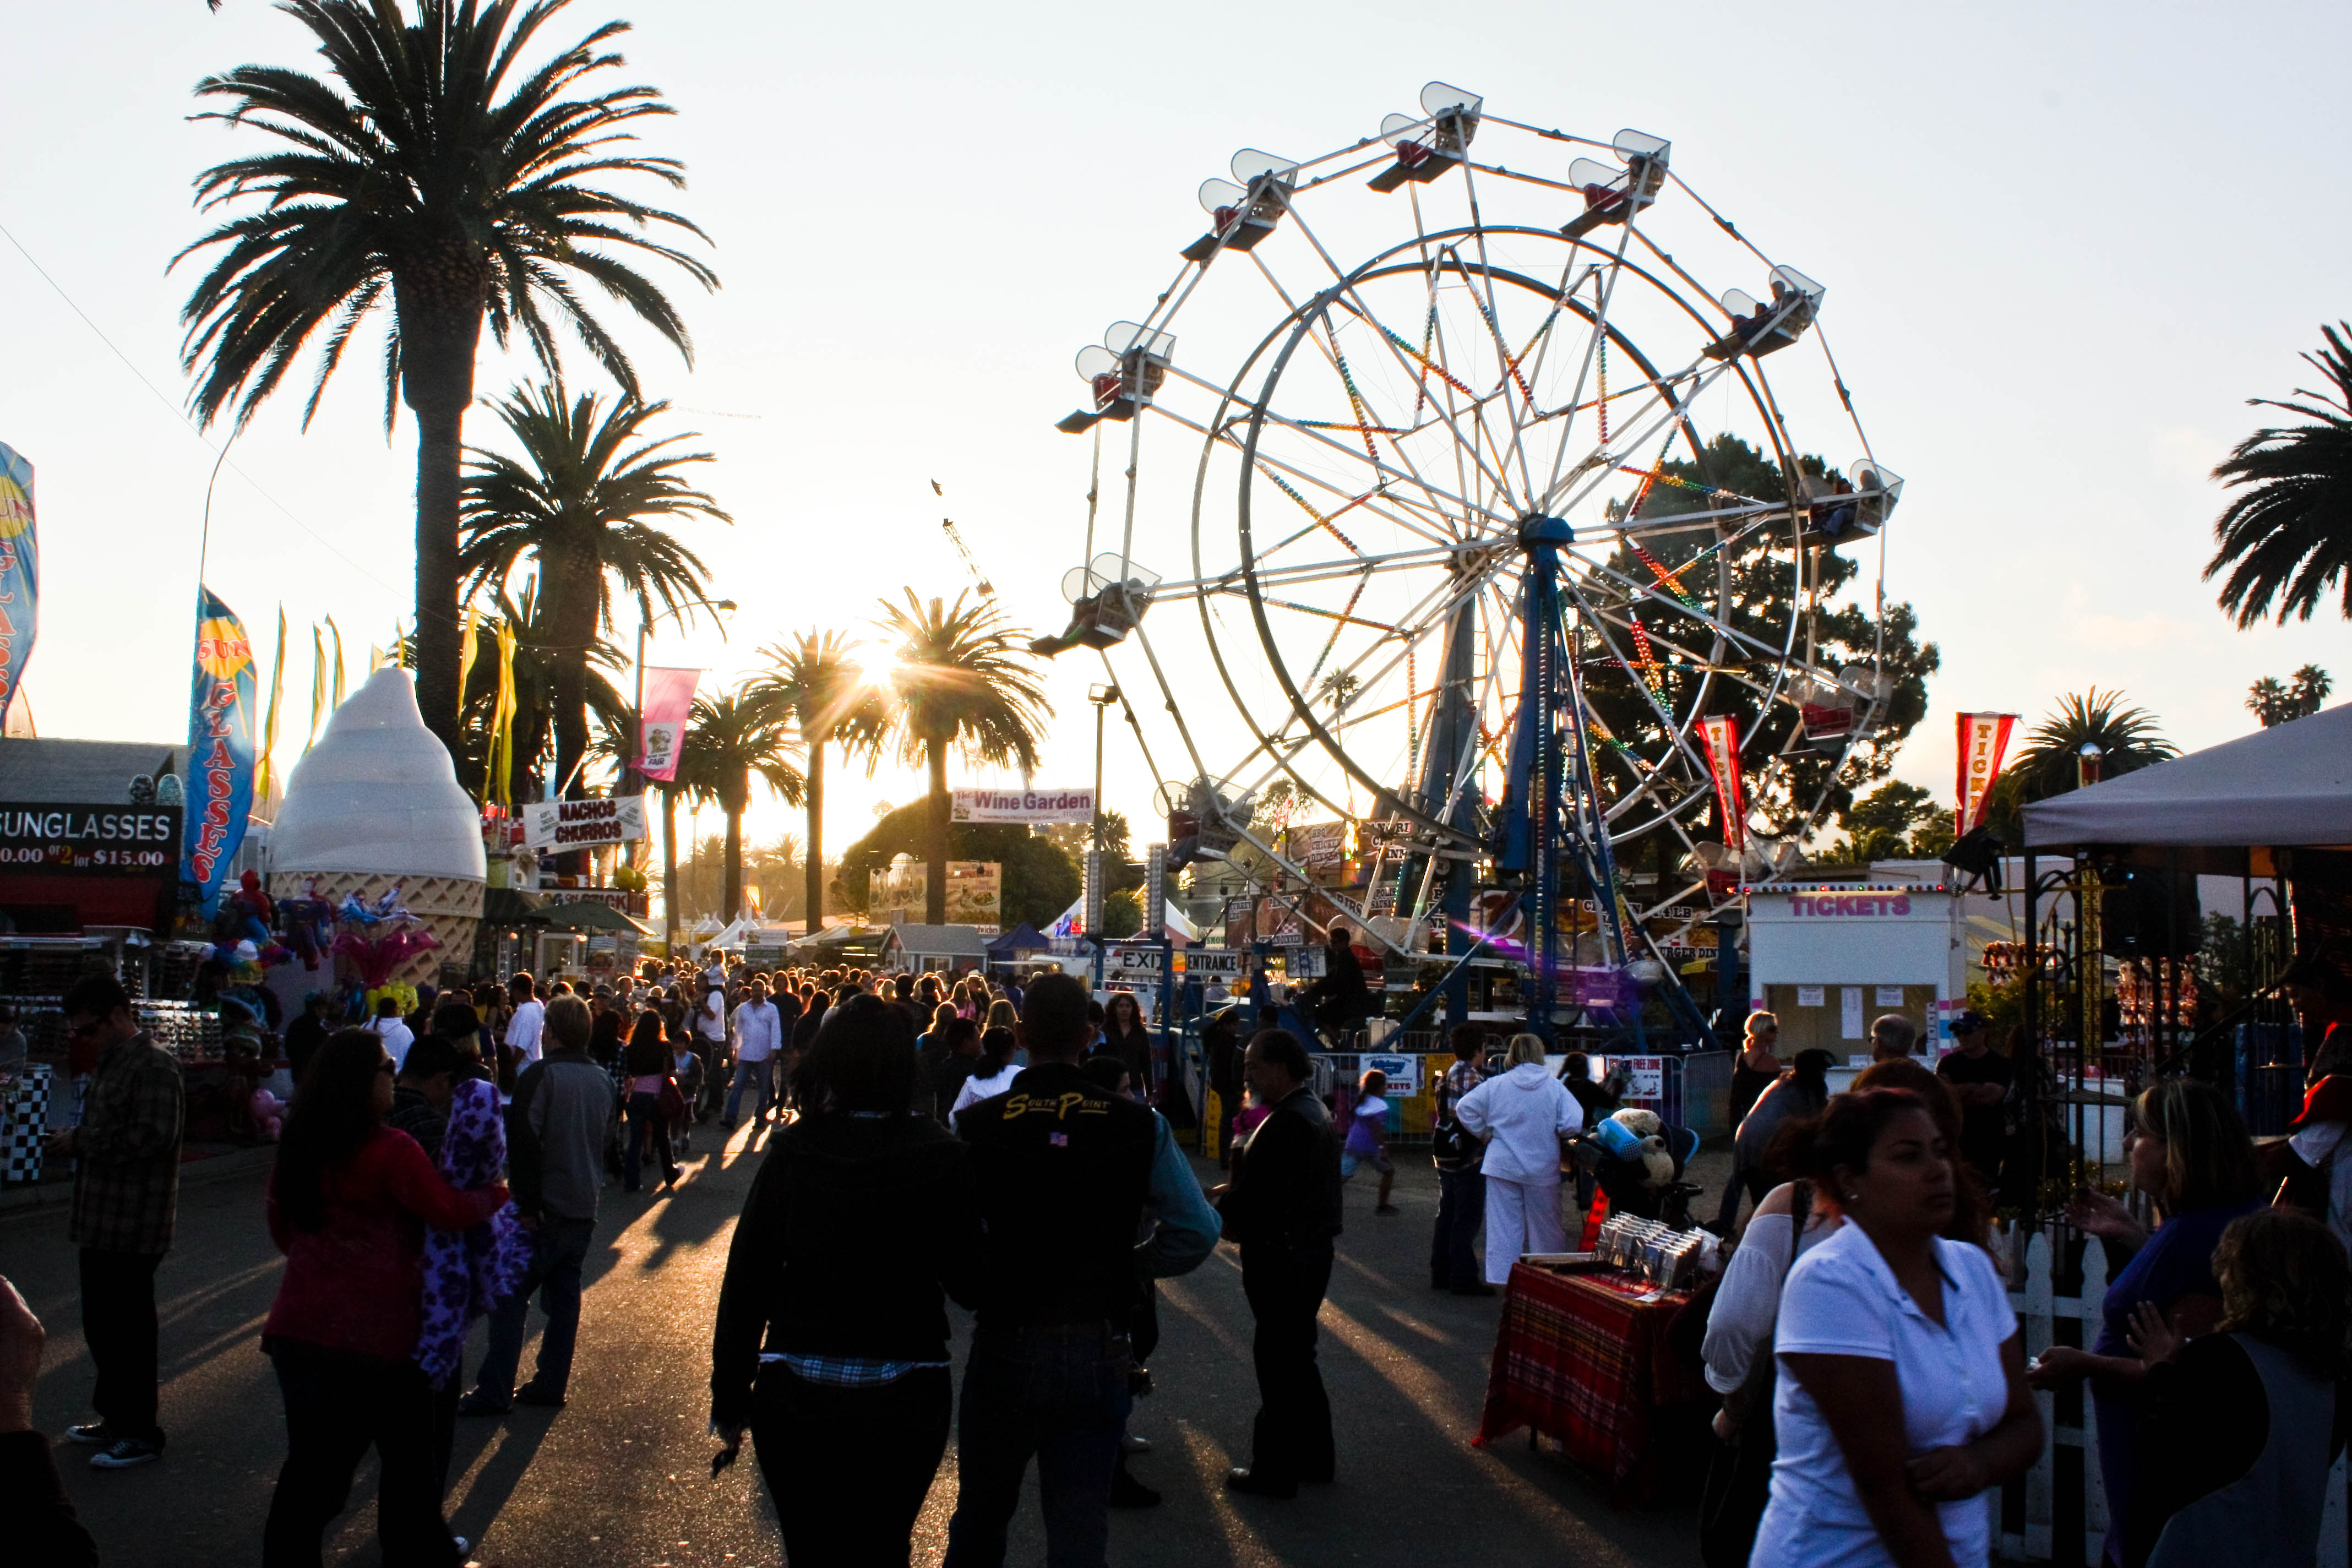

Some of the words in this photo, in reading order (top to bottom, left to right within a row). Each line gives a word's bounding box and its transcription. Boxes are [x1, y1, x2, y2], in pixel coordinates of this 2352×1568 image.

[198, 638, 252, 660] SUN
[648, 758, 665, 766] FAIR
[192, 681, 237, 883] GLASSES
[975, 791, 1020, 810] Wine
[1023, 792, 1091, 810] Garden
[558, 800, 617, 822] NACHOS
[0, 812, 171, 841] UNGLASSES
[555, 820, 623, 843] CHURROS
[48, 845, 61, 856] or
[61, 845, 72, 864] 2
[74, 854, 90, 868] for
[94, 850, 164, 866] $15.00
[1673, 907, 1691, 918] LB
[1788, 895, 1911, 916] TICKETS
[977, 924, 998, 934] dwiches
[1661, 947, 1696, 957] URGER
[1698, 948, 1718, 958] DIN
[1188, 955, 1236, 971] ENTRANCE
[1633, 1058, 1646, 1070] FREE
[1647, 1058, 1660, 1070] ZONE
